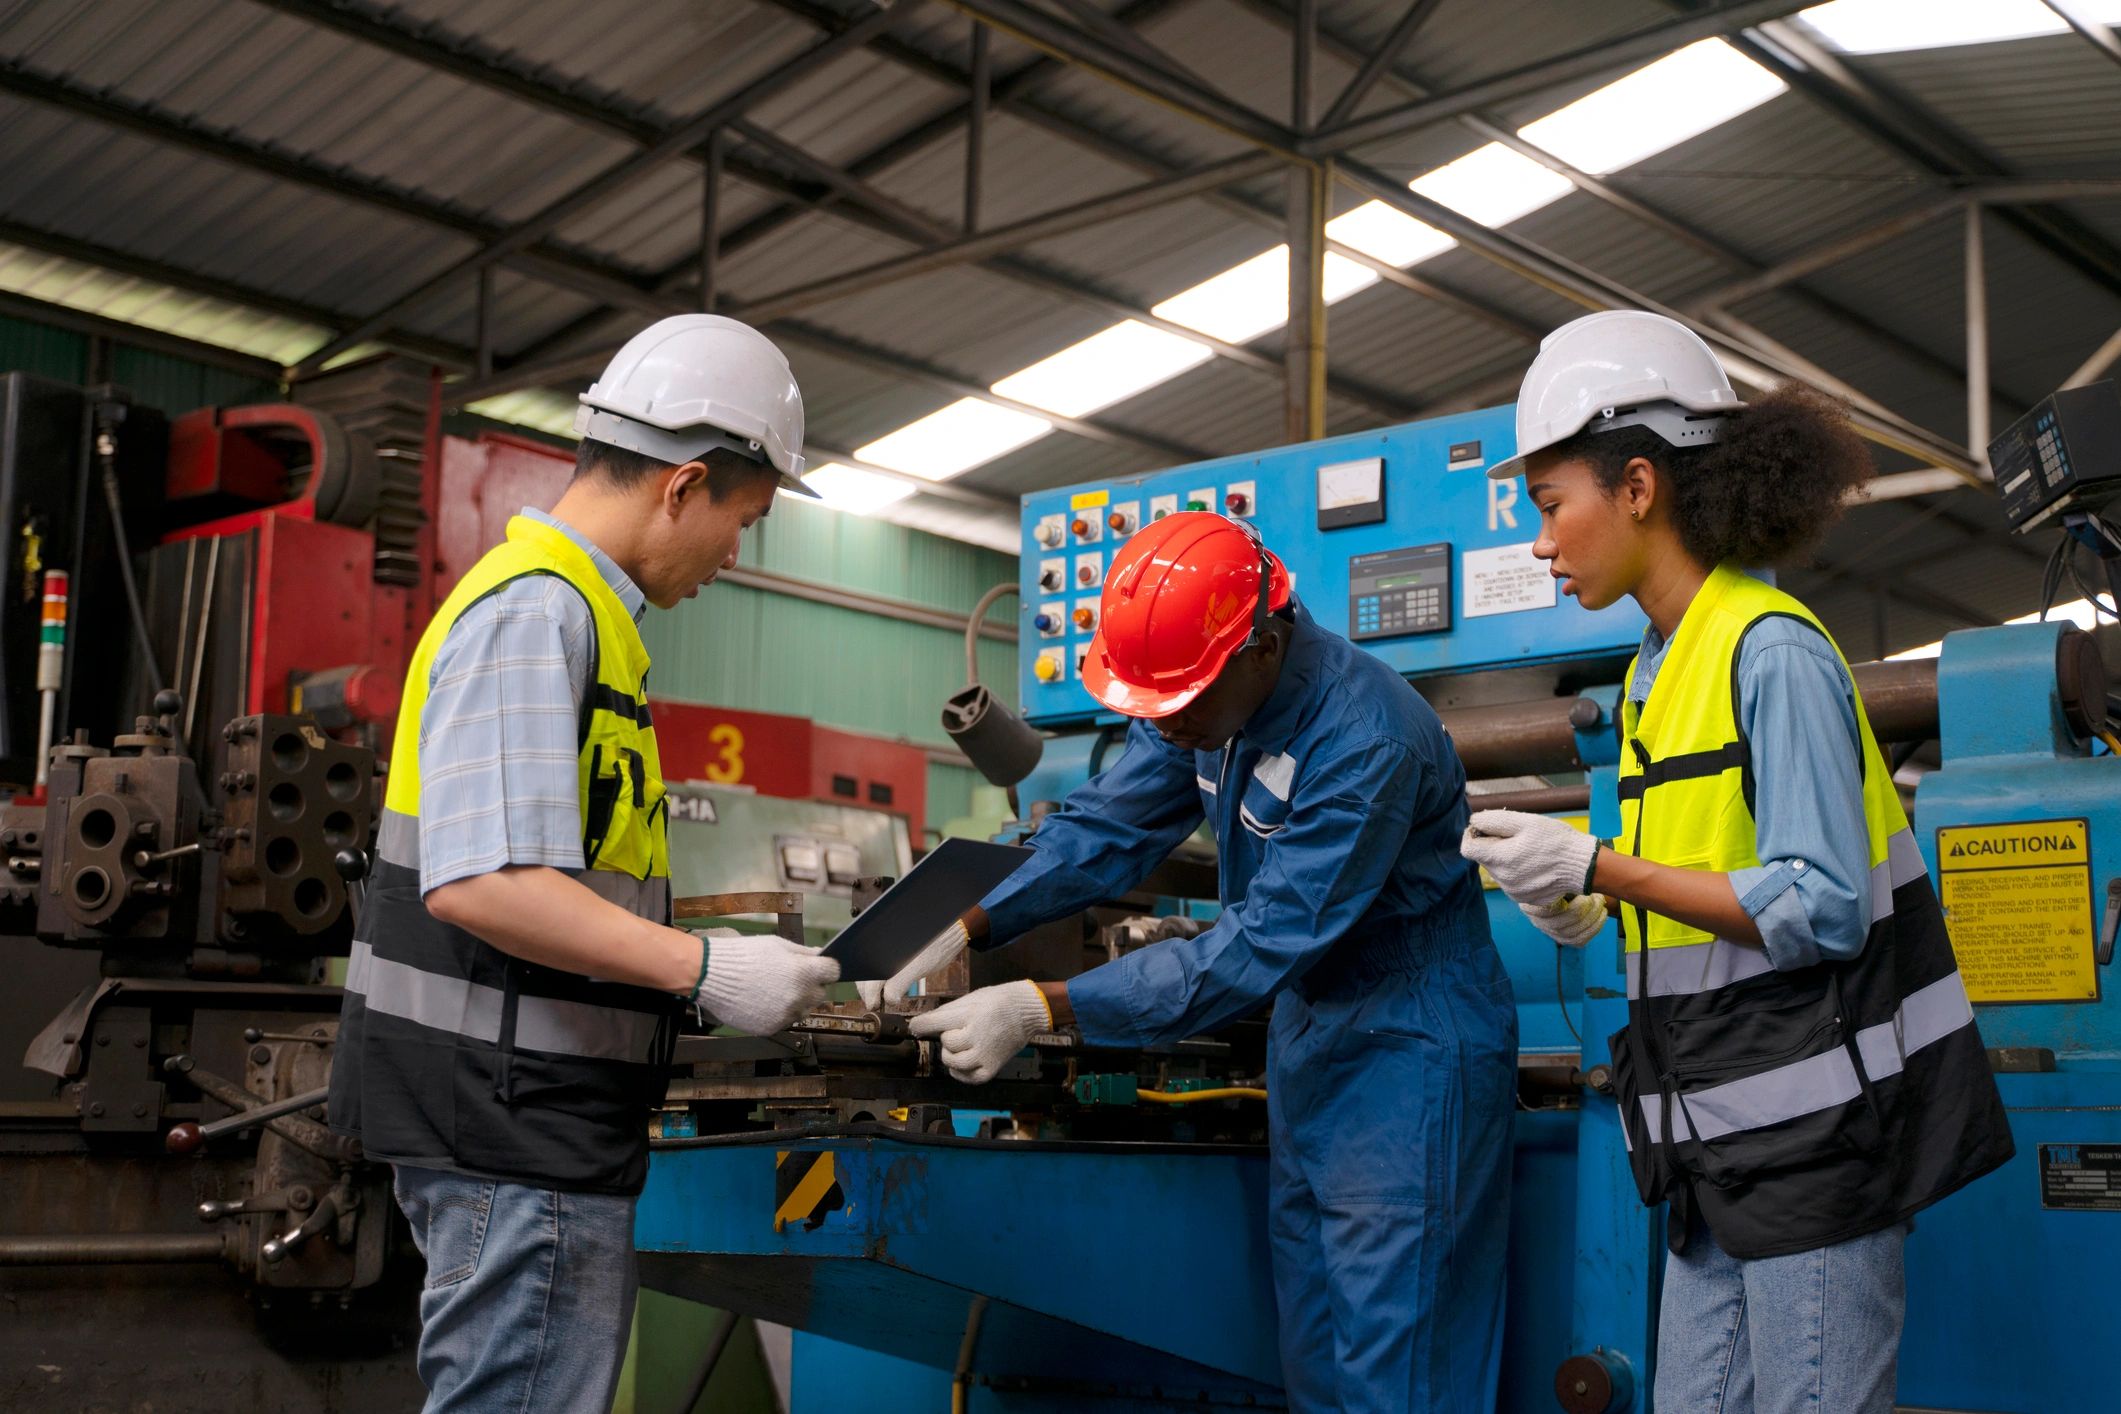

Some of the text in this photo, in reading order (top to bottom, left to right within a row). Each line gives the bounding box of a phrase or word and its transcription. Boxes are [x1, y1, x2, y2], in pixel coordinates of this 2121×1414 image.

[1489, 478, 1518, 530] R
[706, 723, 744, 784] 3
[1967, 836, 2057, 855] CAUTION
